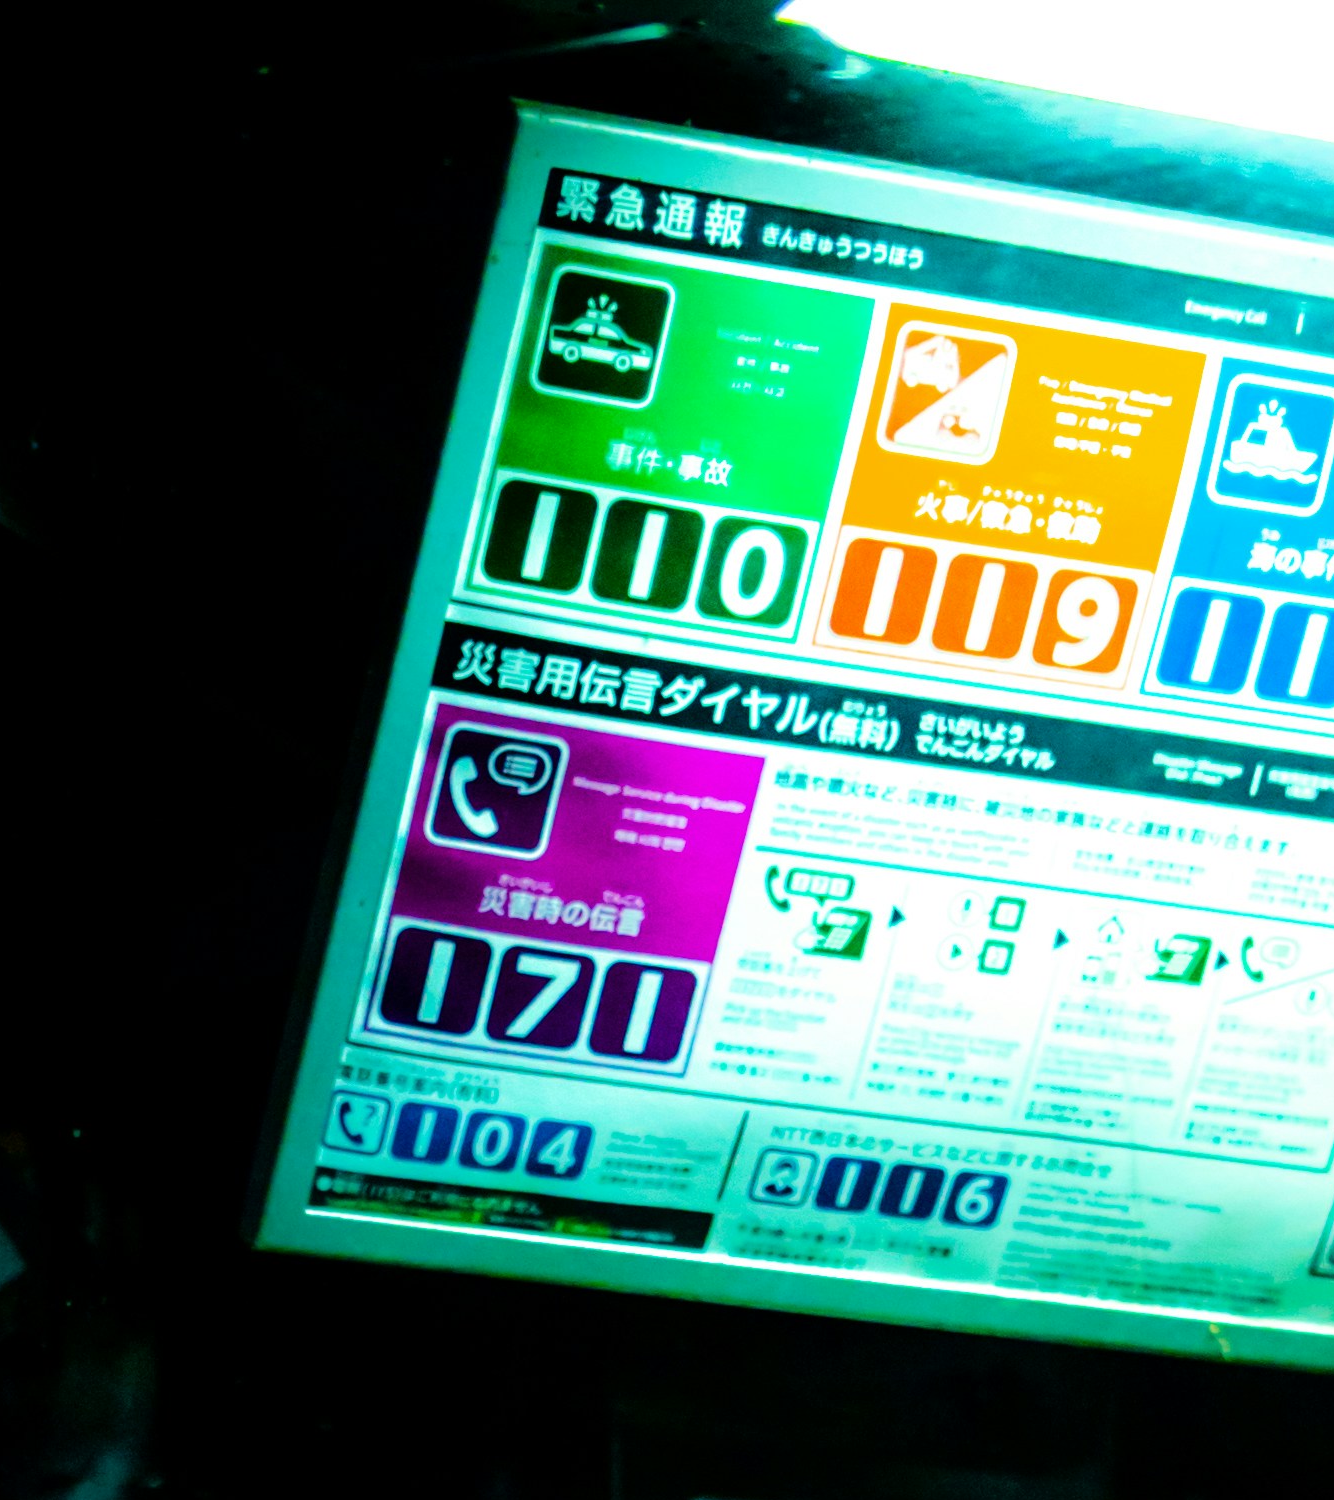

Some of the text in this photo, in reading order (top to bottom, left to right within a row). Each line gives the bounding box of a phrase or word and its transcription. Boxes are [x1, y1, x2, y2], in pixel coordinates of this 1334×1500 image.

[552, 175, 926, 272] 緊急通報 きんきゅうつうほう
[605, 440, 734, 488] 事件・事故
[521, 492, 785, 618] 110
[863, 547, 1120, 667] 119
[451, 641, 905, 752] 災害用伝言ダイヤル(無料)
[916, 712, 1026, 745] さいがいよう
[912, 732, 1055, 773] でんごんダイヤル
[476, 885, 647, 937] 災害時の伝言
[418, 939, 664, 1054] 171
[413, 1109, 575, 1175] 104
[835, 1161, 991, 1224] 116
